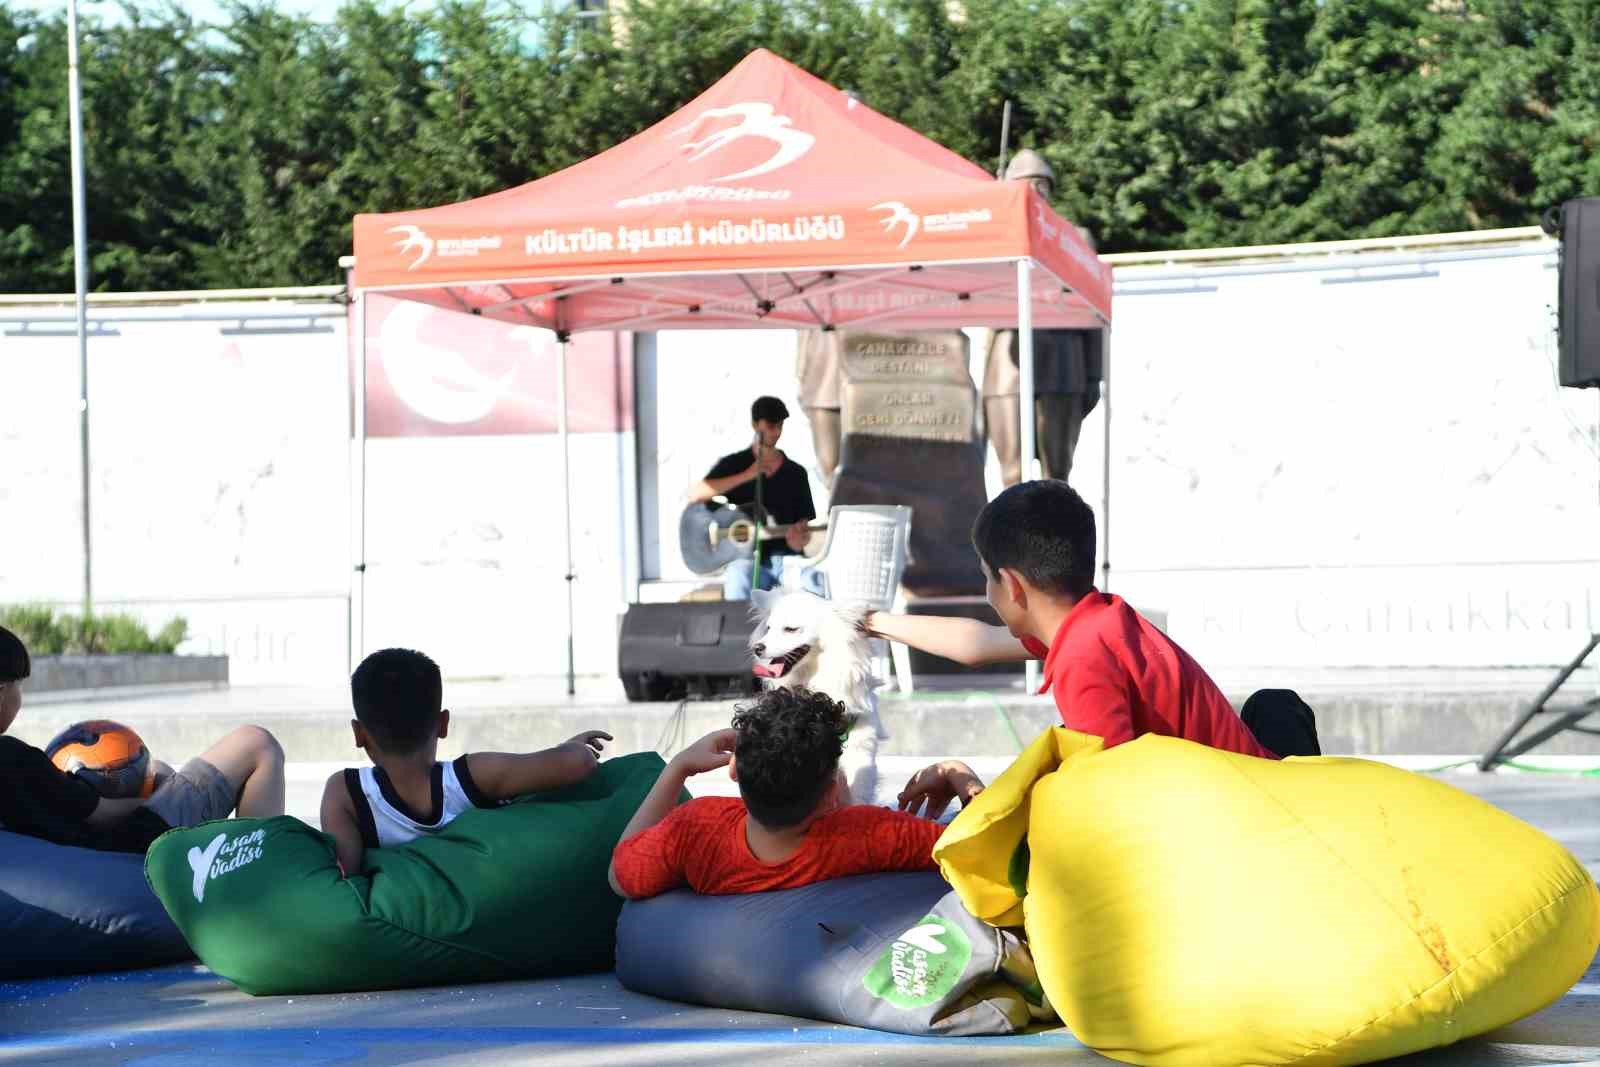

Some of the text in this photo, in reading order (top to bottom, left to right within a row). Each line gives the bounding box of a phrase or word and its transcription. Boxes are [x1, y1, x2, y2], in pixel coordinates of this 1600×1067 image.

[525, 226, 612, 255] KÜLTÜR
[618, 222, 692, 254] İŞLERİ
[699, 215, 845, 246] MÜDÜRLÜĞÜ
